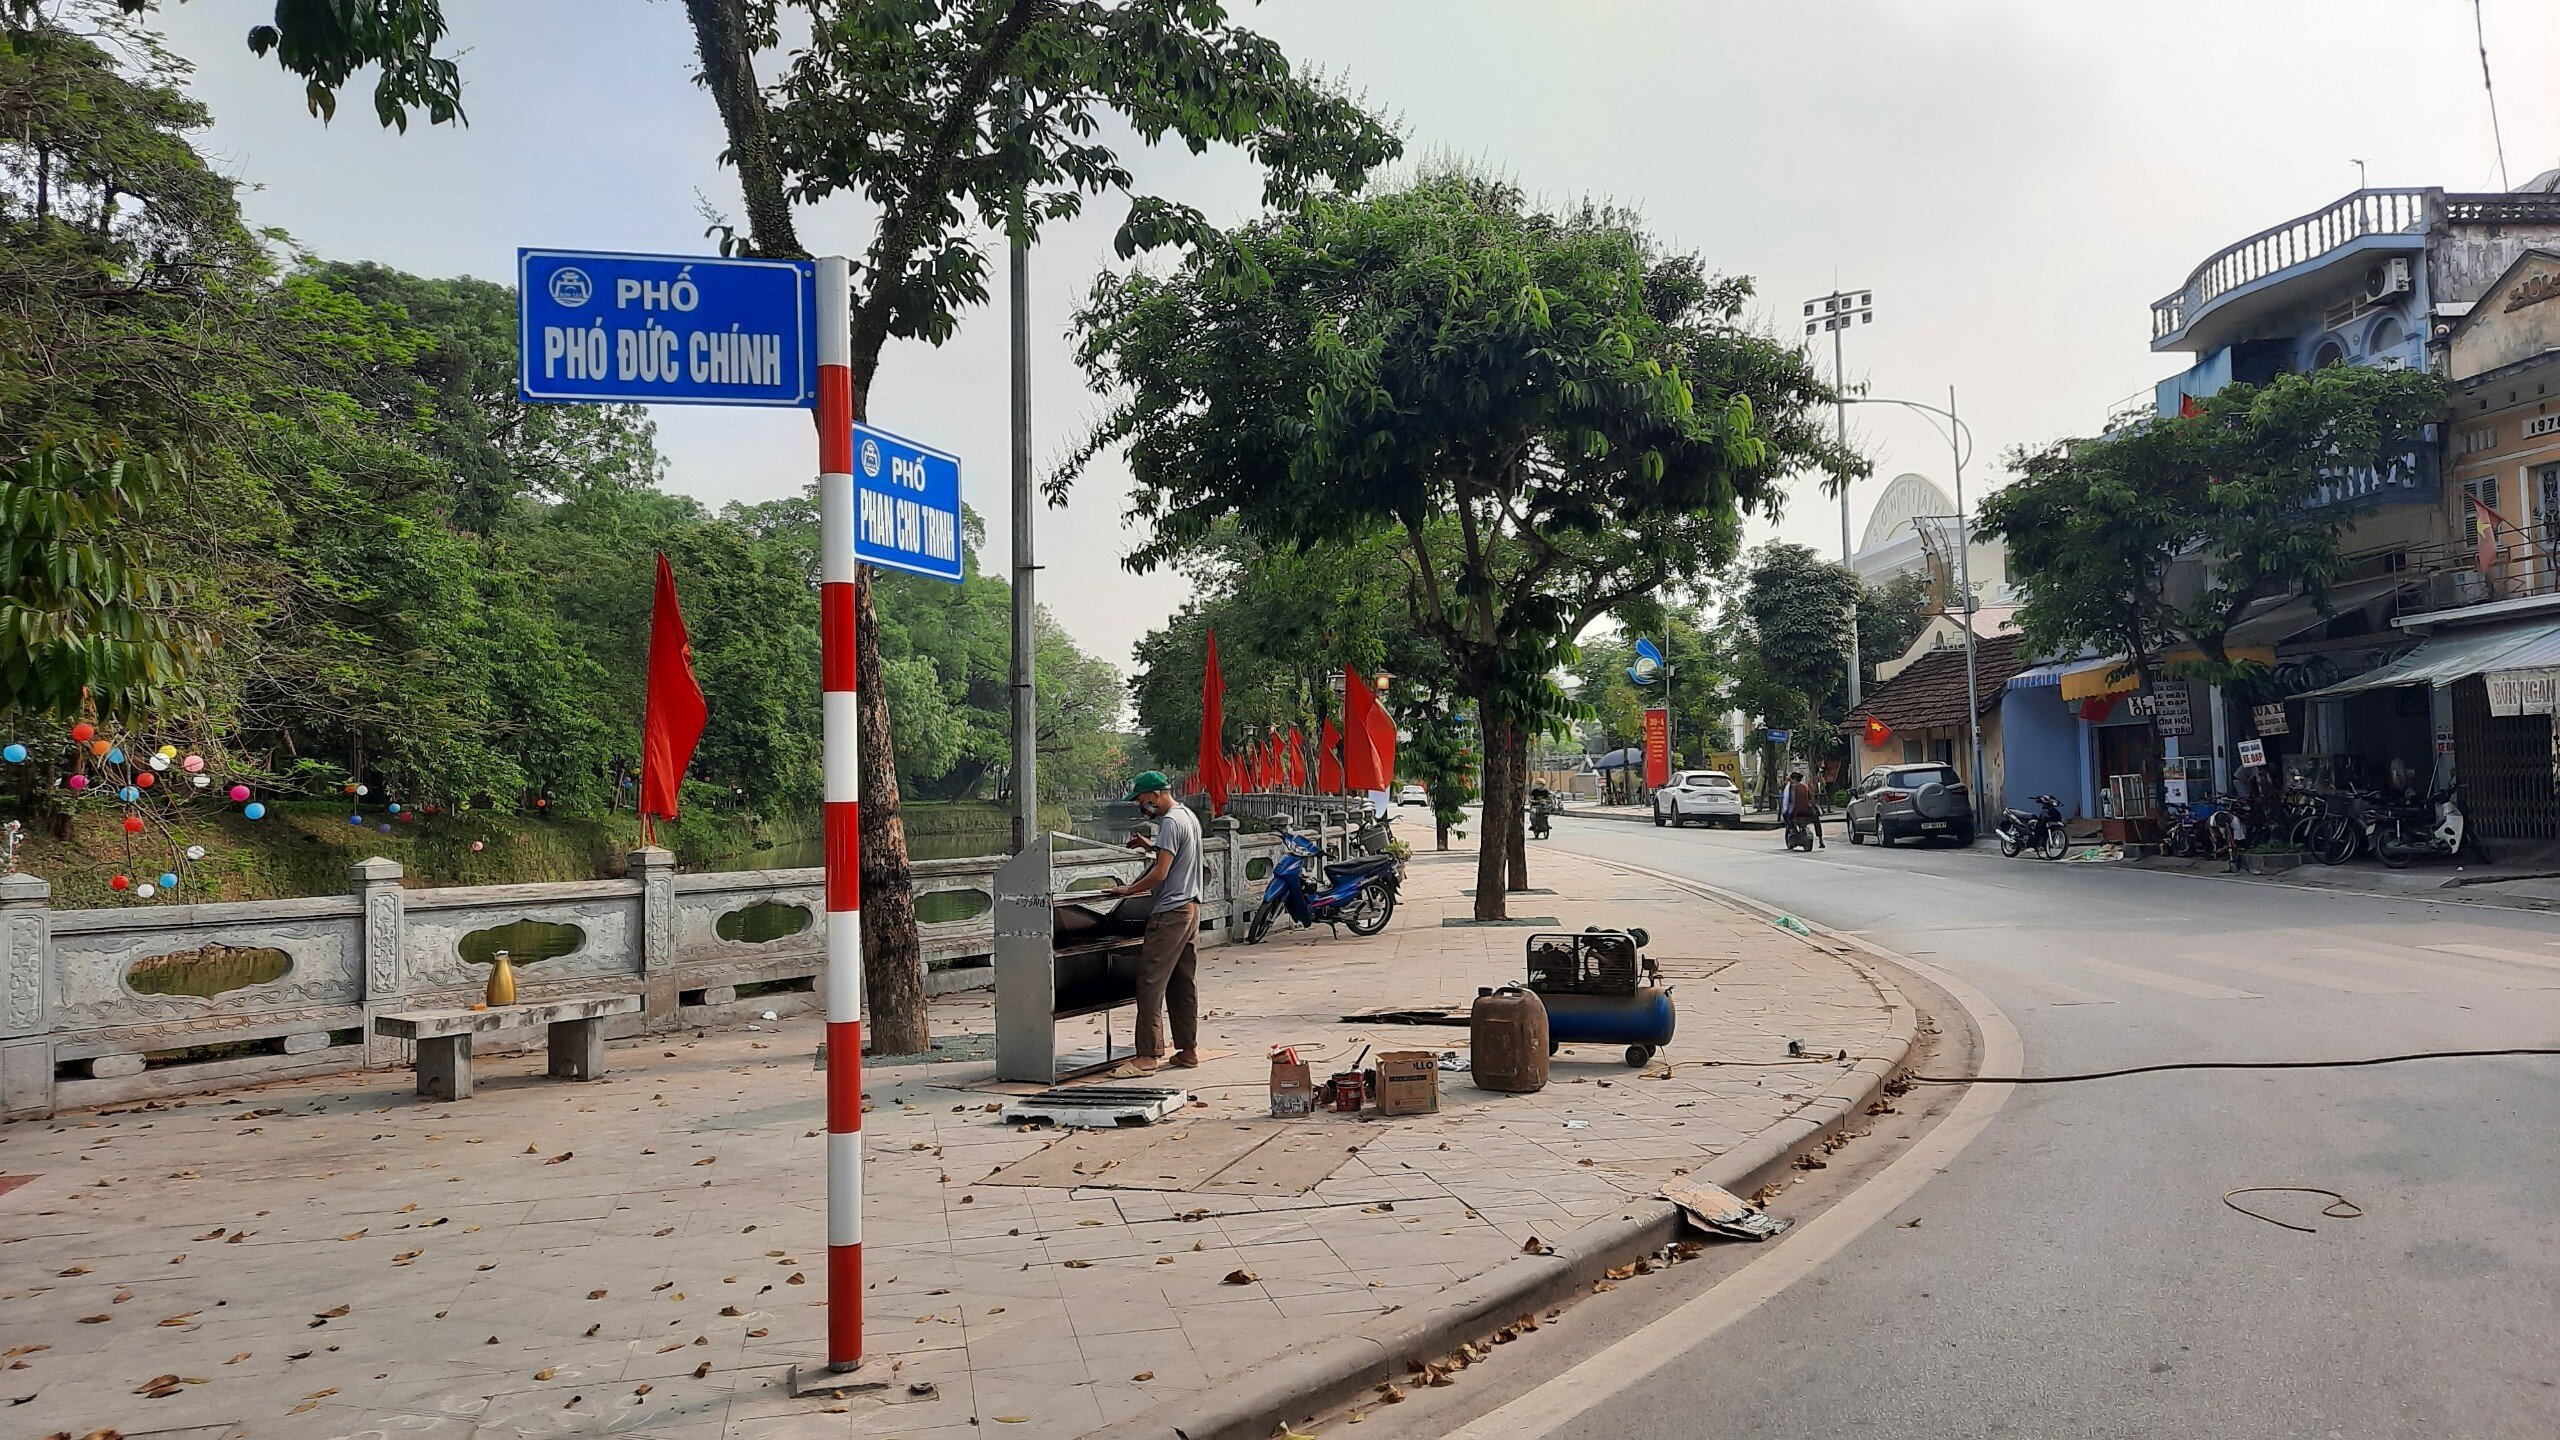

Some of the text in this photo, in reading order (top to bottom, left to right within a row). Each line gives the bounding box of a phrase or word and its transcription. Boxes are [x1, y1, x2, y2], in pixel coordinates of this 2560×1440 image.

[617, 265, 699, 312] PHỐ
[544, 317, 781, 386] PHÓ ĐỨC CHÍNH
[892, 455, 926, 492] PHỐ
[860, 487, 955, 561] PHAN CHU TRINH
[2520, 679, 2557, 704] NGAN
[1649, 717, 1665, 727] 30-4
